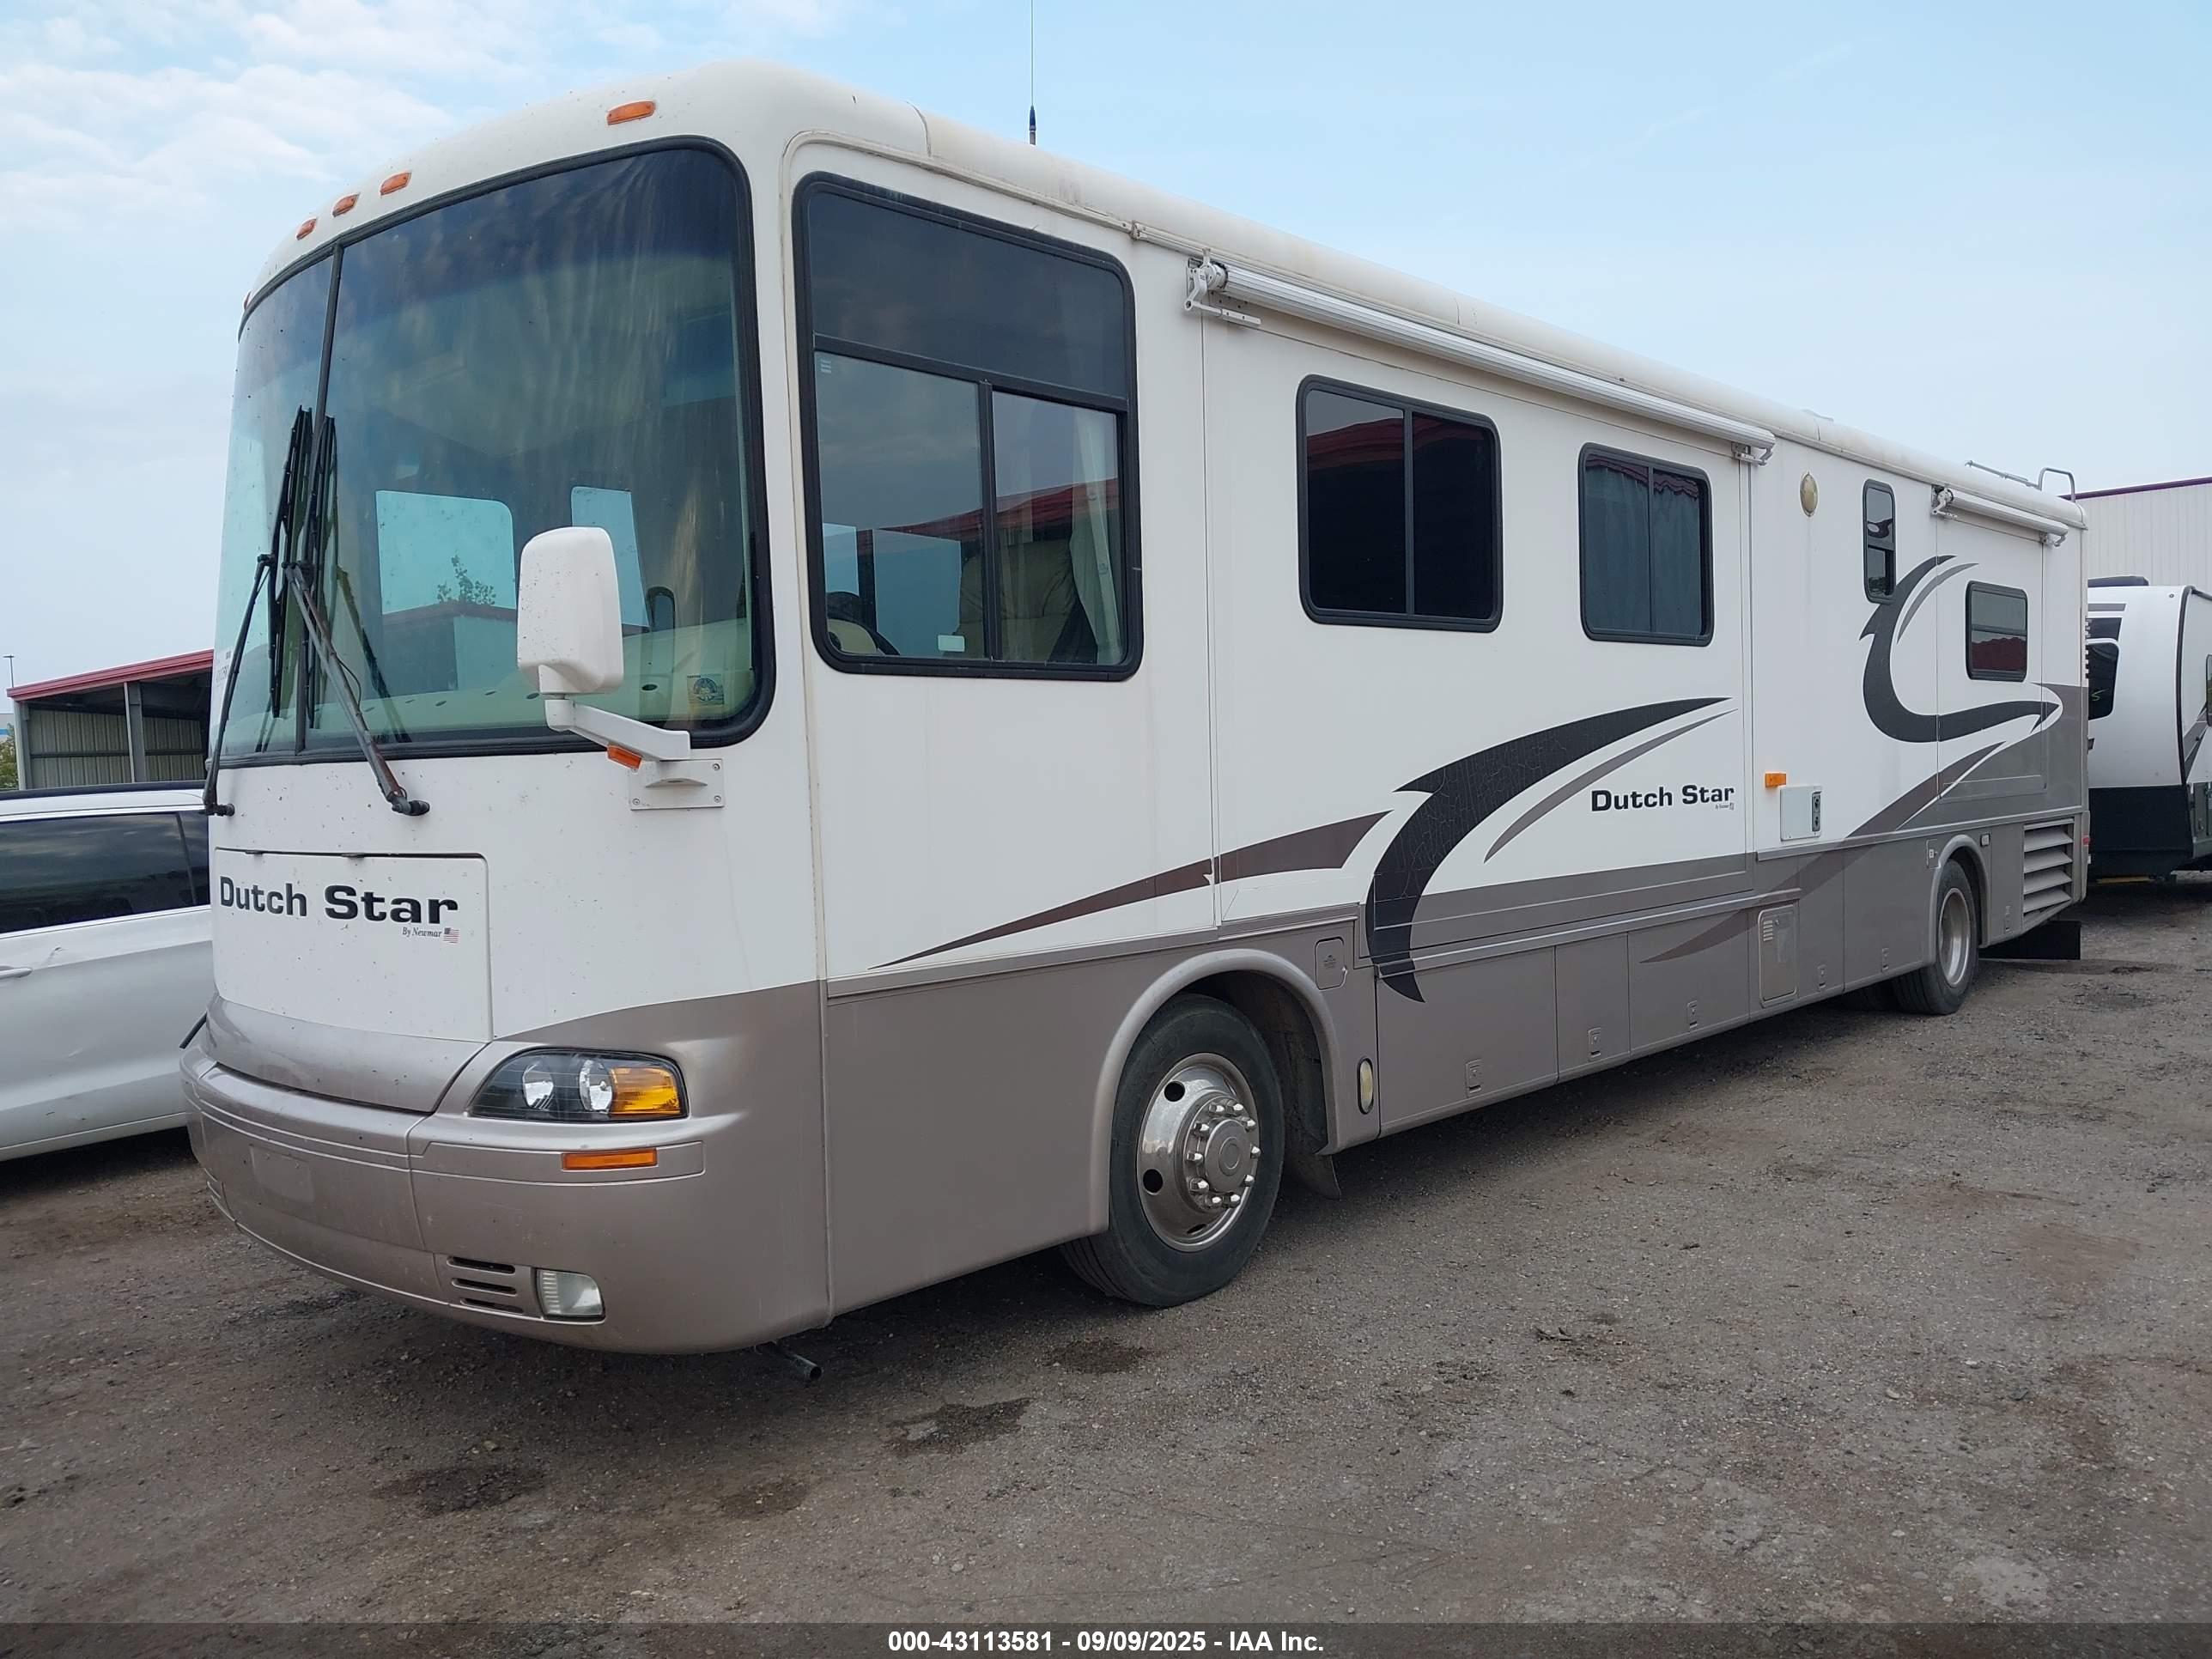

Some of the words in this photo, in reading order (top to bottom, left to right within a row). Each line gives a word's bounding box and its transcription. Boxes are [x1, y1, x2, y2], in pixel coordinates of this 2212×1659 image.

[1591, 787, 1673, 811] Dutch
[1682, 784, 1735, 805] Star
[220, 876, 307, 917] Dutch
[325, 884, 459, 925] Star
[403, 927, 410, 938] By
[412, 927, 442, 938] Newmar
